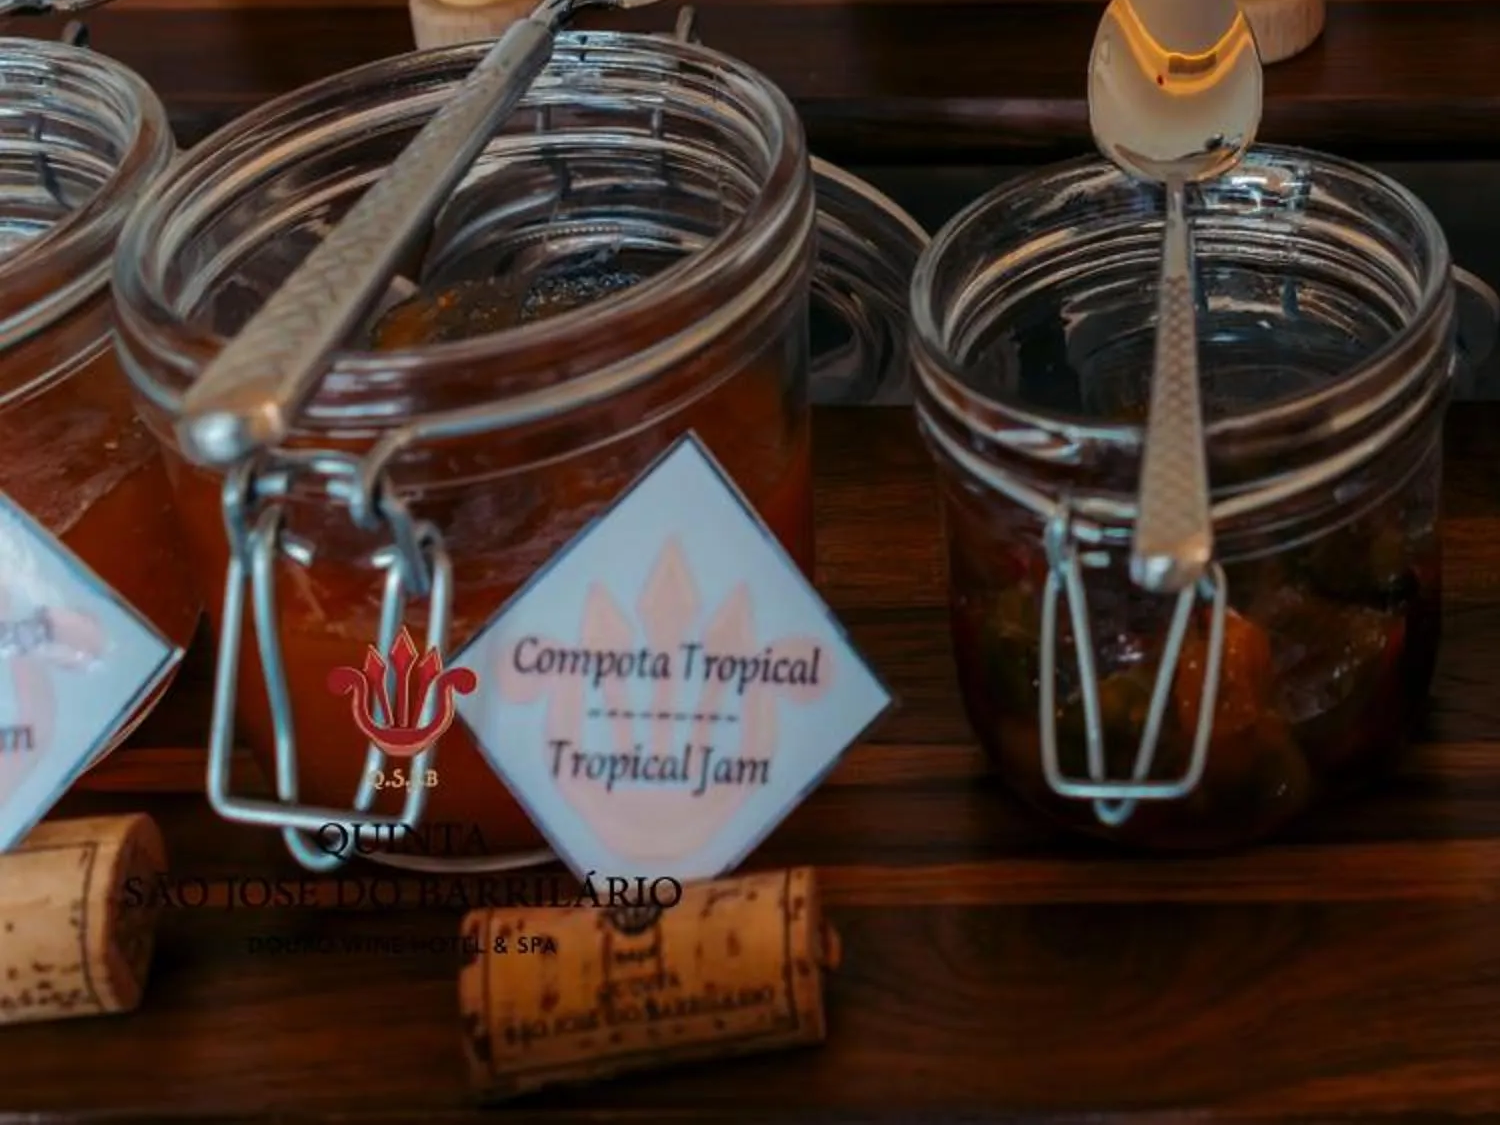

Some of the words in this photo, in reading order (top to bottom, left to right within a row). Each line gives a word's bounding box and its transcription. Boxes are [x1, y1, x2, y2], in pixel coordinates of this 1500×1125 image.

[512, 633, 671, 690] Compota
[678, 642, 822, 696] Tropical
[548, 738, 691, 794] Tropical
[691, 746, 771, 797] Jam
